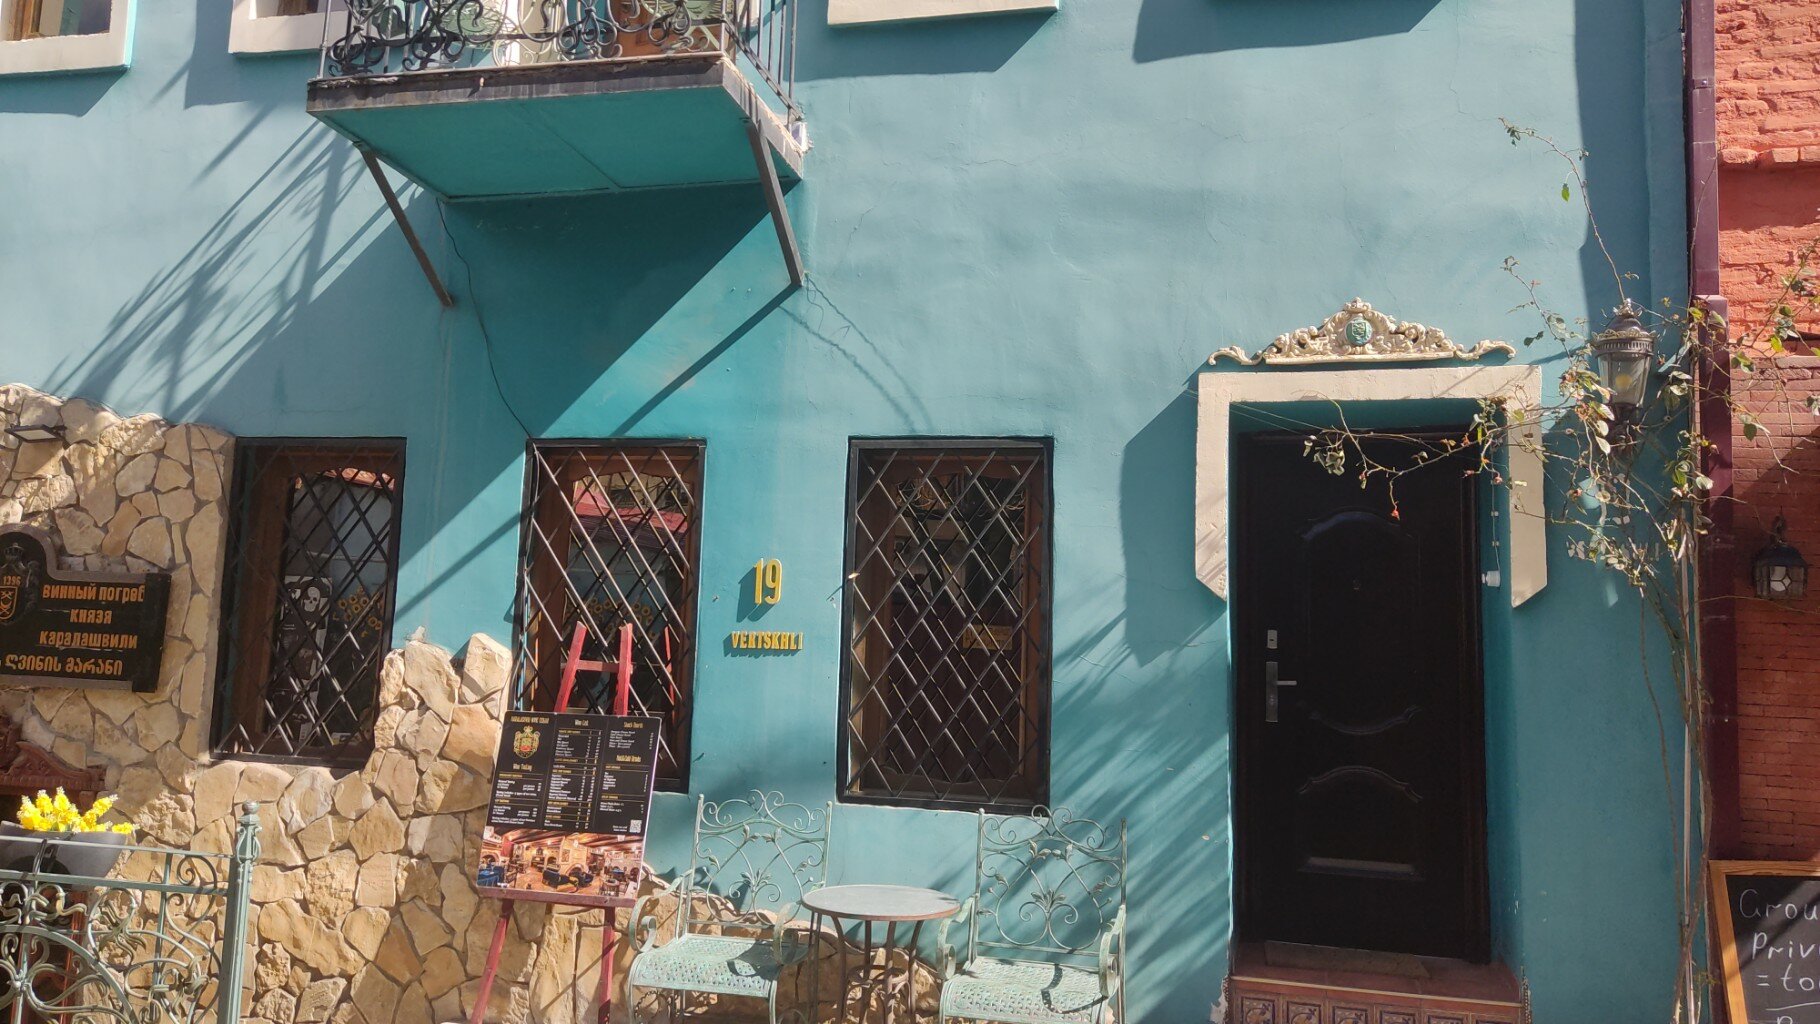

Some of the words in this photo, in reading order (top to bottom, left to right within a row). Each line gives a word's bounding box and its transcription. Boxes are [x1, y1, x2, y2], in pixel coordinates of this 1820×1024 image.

[753, 557, 782, 605] 19
[731, 630, 804, 650] VERTSKHLI
[1752, 931, 1820, 960] Priv
[1780, 963, 1820, 992] to
